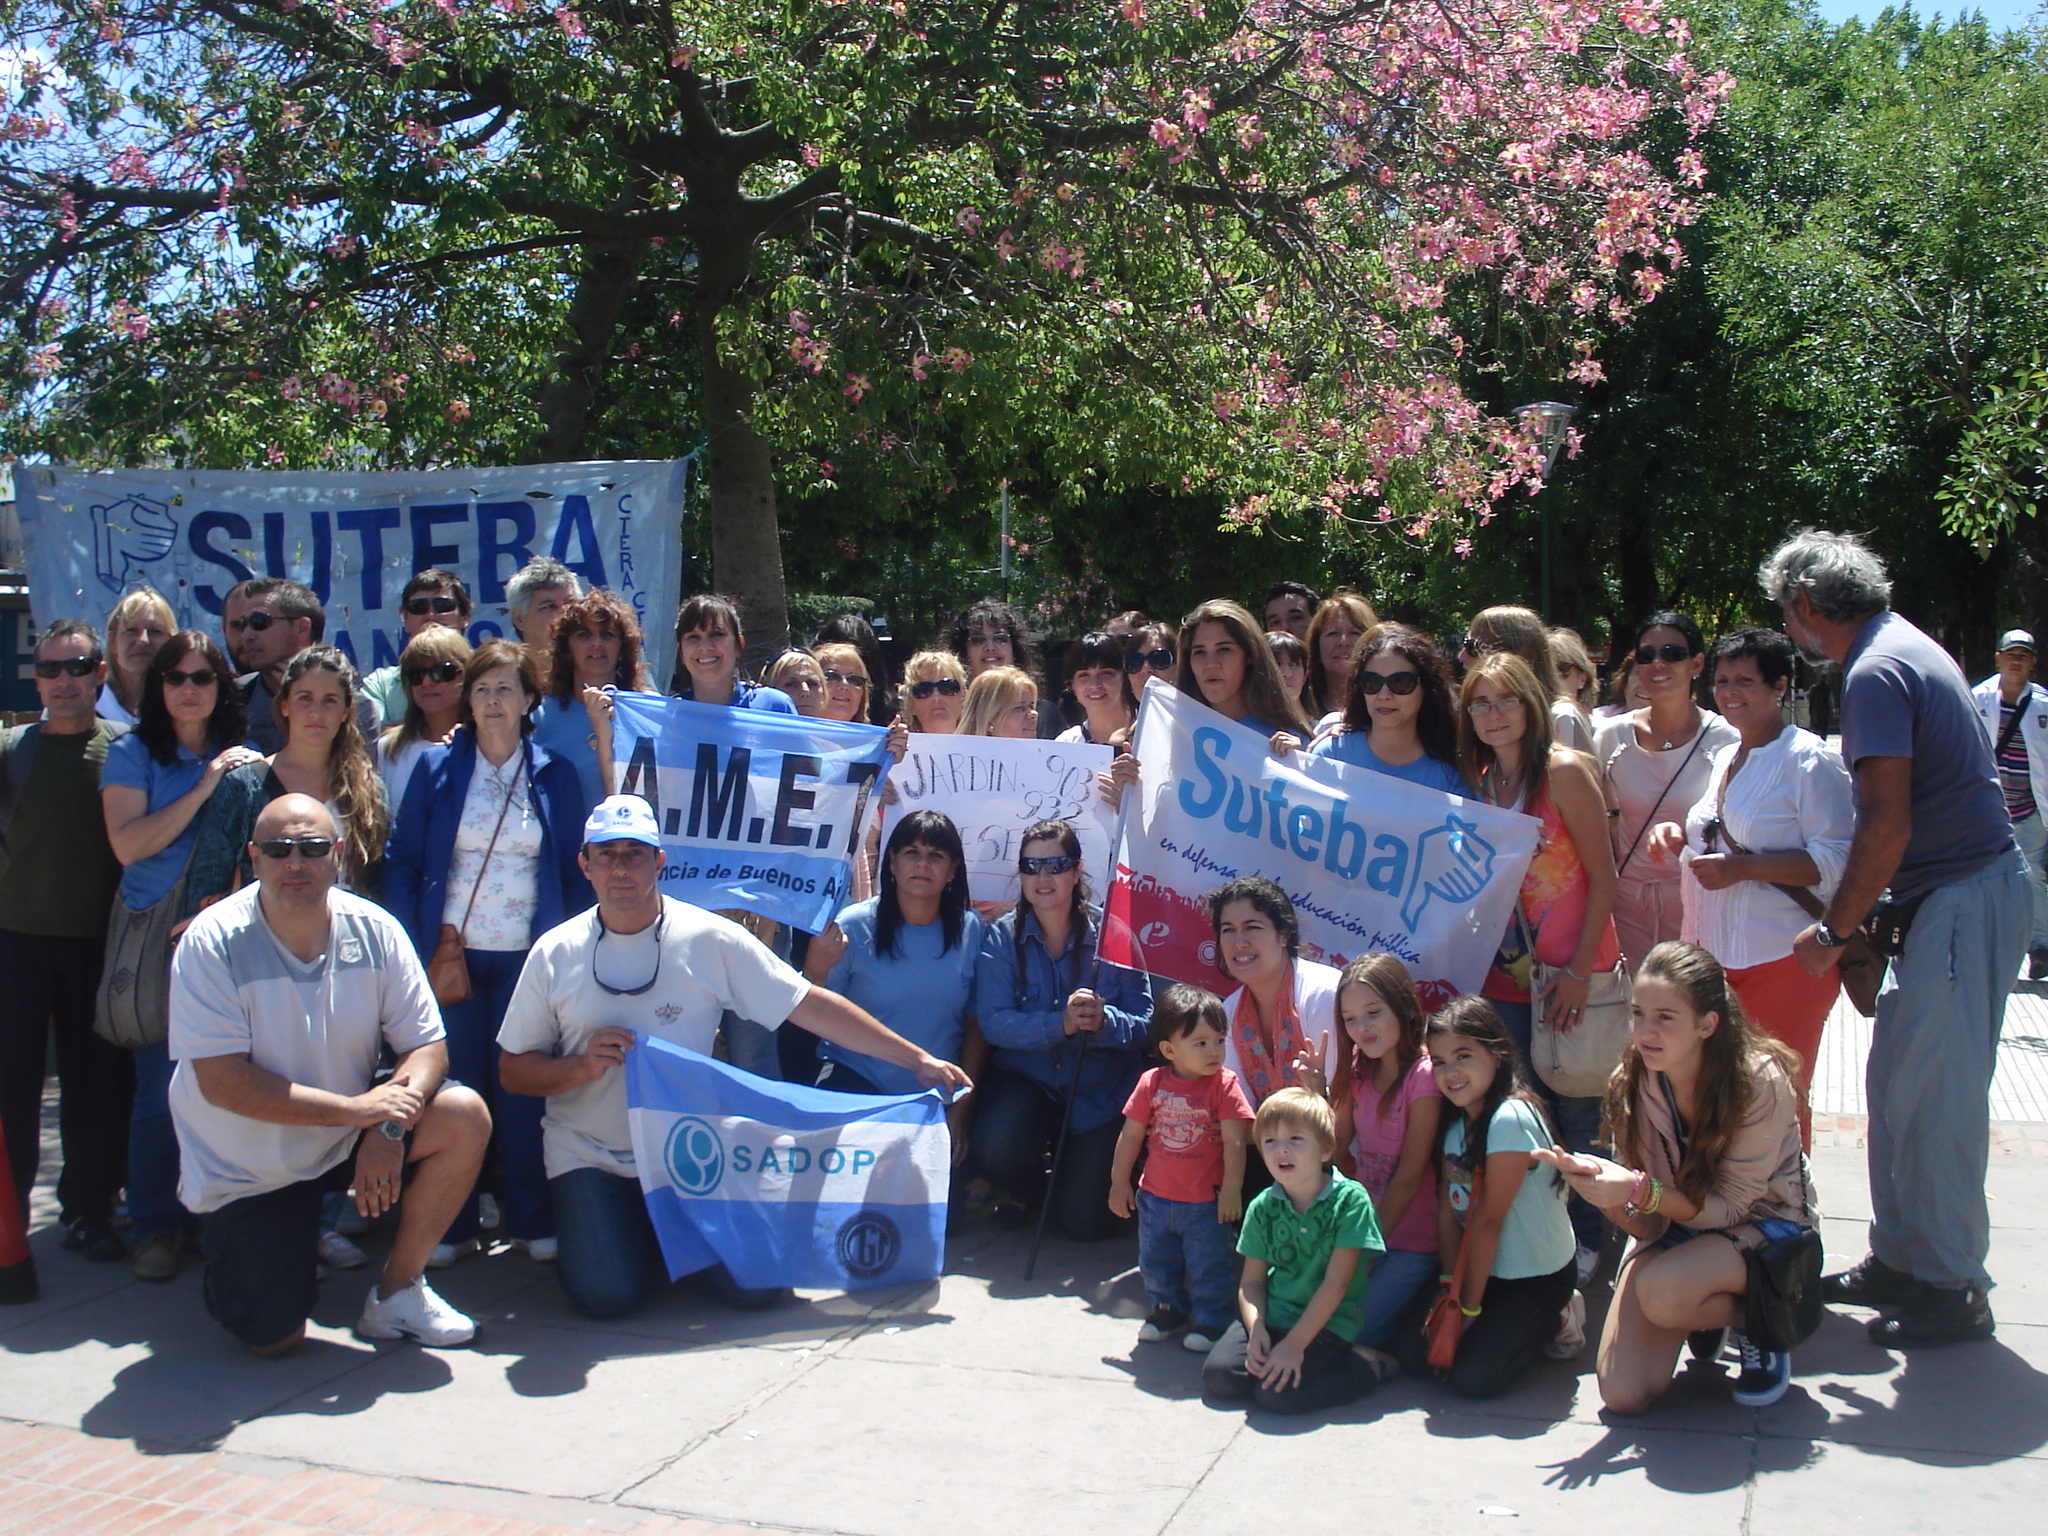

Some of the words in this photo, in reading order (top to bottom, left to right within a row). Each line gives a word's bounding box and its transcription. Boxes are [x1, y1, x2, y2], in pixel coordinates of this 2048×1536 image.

[188, 495, 609, 616] SUTEBA
[618, 494, 635, 592] CTERA
[1178, 726, 1409, 898] Suteba
[705, 863, 732, 879] de
[738, 864, 816, 894] Buenos
[1160, 837, 1178, 853] en
[1181, 843, 1238, 879] defensa
[1289, 891, 1367, 938] educación
[1368, 931, 1420, 964] pública
[732, 1144, 876, 1176] SADOP
